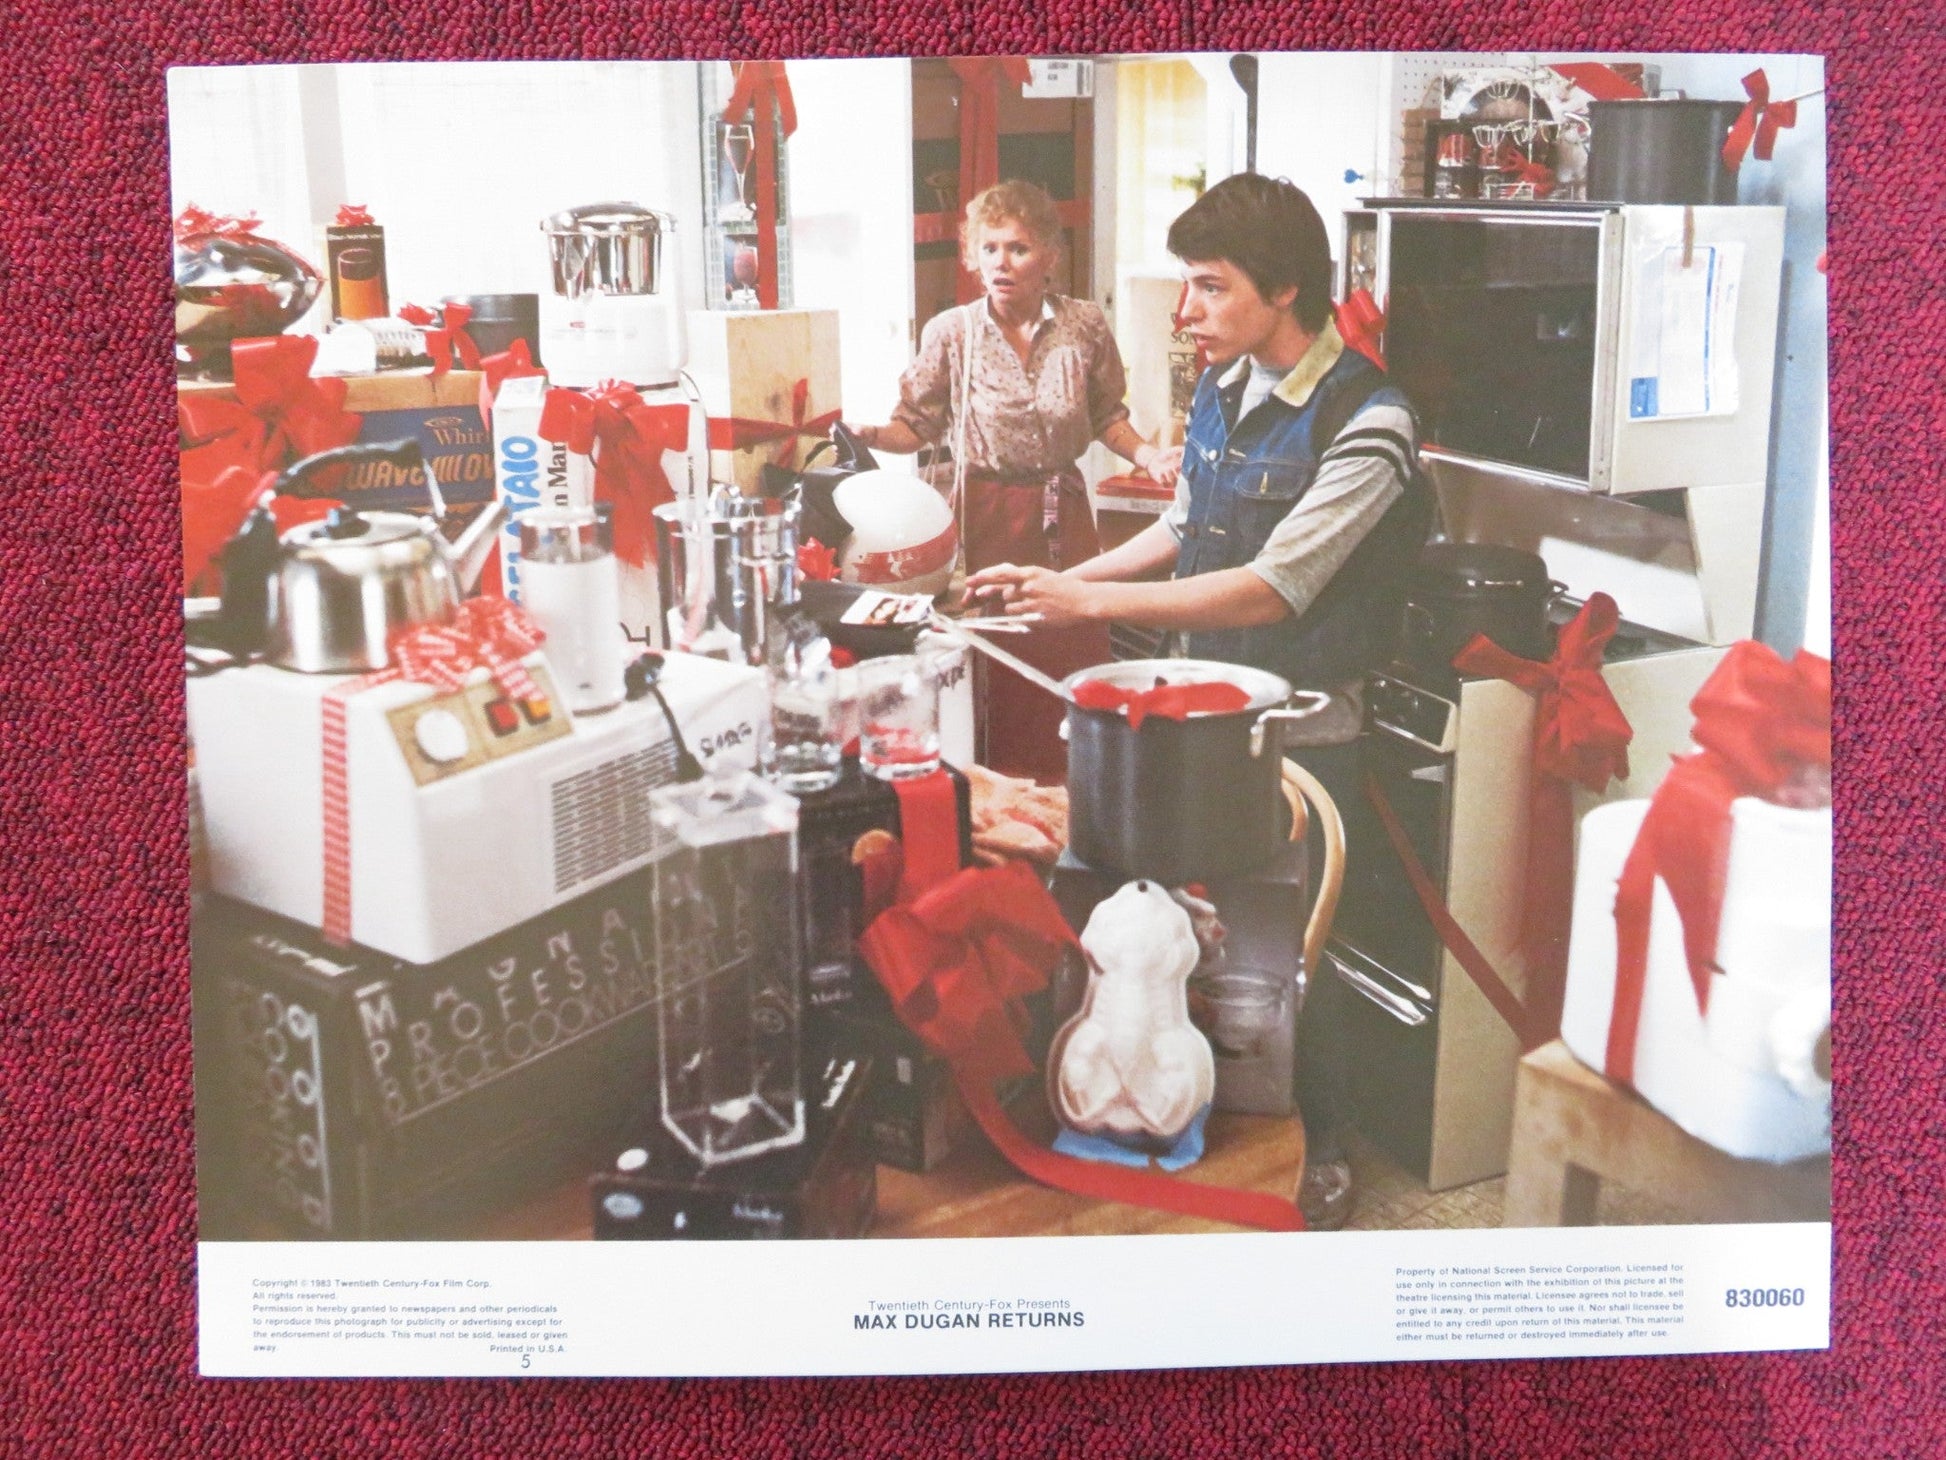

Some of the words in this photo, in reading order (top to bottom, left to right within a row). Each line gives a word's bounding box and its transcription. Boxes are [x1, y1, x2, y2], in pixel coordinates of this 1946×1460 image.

[1396, 1268, 1435, 1277] Property
[1439, 1268, 1448, 1277] of
[1452, 1267, 1490, 1275] National
[1494, 1266, 1526, 1274] Screen
[1529, 1265, 1562, 1273] Service
[1627, 1264, 1668, 1272] Licensed
[252, 1279, 297, 1289] Copyright
[311, 1279, 331, 1287] 1983
[335, 1279, 379, 1287] Twentieth
[383, 1280, 439, 1289] Century-Fox
[443, 1279, 463, 1287] Film
[1415, 1281, 1435, 1290] only
[1450, 1280, 1501, 1288] connection
[1592, 1278, 1602, 1286] of
[1624, 1278, 1655, 1286] picture
[268, 1292, 293, 1301] rights
[1396, 1294, 1428, 1302] theatre
[1431, 1293, 1472, 1303] licensing
[1536, 1292, 1576, 1300] Licensee
[1579, 1292, 1609, 1301] agrees
[1612, 1290, 1627, 1298] not
[1629, 1290, 1638, 1298] to
[1726, 1288, 1804, 1307] 830060
[253, 1304, 303, 1312] Permission
[317, 1305, 347, 1314] hereby
[351, 1305, 386, 1314] granted
[402, 1306, 455, 1315] newspapers
[459, 1305, 476, 1313] and
[479, 1305, 503, 1313] other
[507, 1305, 557, 1314] periodicals
[869, 1301, 928, 1310] Twentieth
[935, 1299, 1012, 1310] Century-Fox
[1018, 1299, 1070, 1308] Presents
[1409, 1308, 1427, 1316] give
[1482, 1305, 1511, 1315] permit
[1515, 1305, 1543, 1313] others
[1609, 1304, 1630, 1312] shall
[1633, 1303, 1670, 1313] licensee
[265, 1318, 311, 1326] reproduce
[334, 1318, 387, 1327] photograph
[390, 1318, 403, 1326] for
[406, 1318, 445, 1327] publicity
[462, 1318, 512, 1327] advertising
[516, 1319, 546, 1327] except
[550, 1318, 562, 1326] for
[854, 1314, 897, 1329] MAX
[905, 1313, 979, 1329] DUGAN
[989, 1312, 1084, 1328] RETURNS
[1396, 1320, 1430, 1328] entitled
[1434, 1320, 1443, 1328] to
[1466, 1319, 1491, 1327] credit
[1495, 1320, 1518, 1328] upon
[1522, 1319, 1549, 1328] return
[1552, 1318, 1561, 1326] of
[1564, 1317, 1580, 1325] this
[1625, 1316, 1645, 1324] This
[332, 1330, 342, 1339] of
[392, 1330, 411, 1339] This
[414, 1330, 436, 1339] must
[440, 1331, 455, 1339] not
[458, 1331, 469, 1339] be
[498, 1331, 527, 1339] leased
[543, 1330, 567, 1341] given
[1396, 1333, 1422, 1341] either
[1466, 1332, 1505, 1340] returned
[1520, 1331, 1566, 1340] destroyed
[1569, 1330, 1624, 1339] immediately
[1628, 1329, 1647, 1337] after
[526, 1345, 535, 1353] in
[521, 1354, 530, 1368] 5
